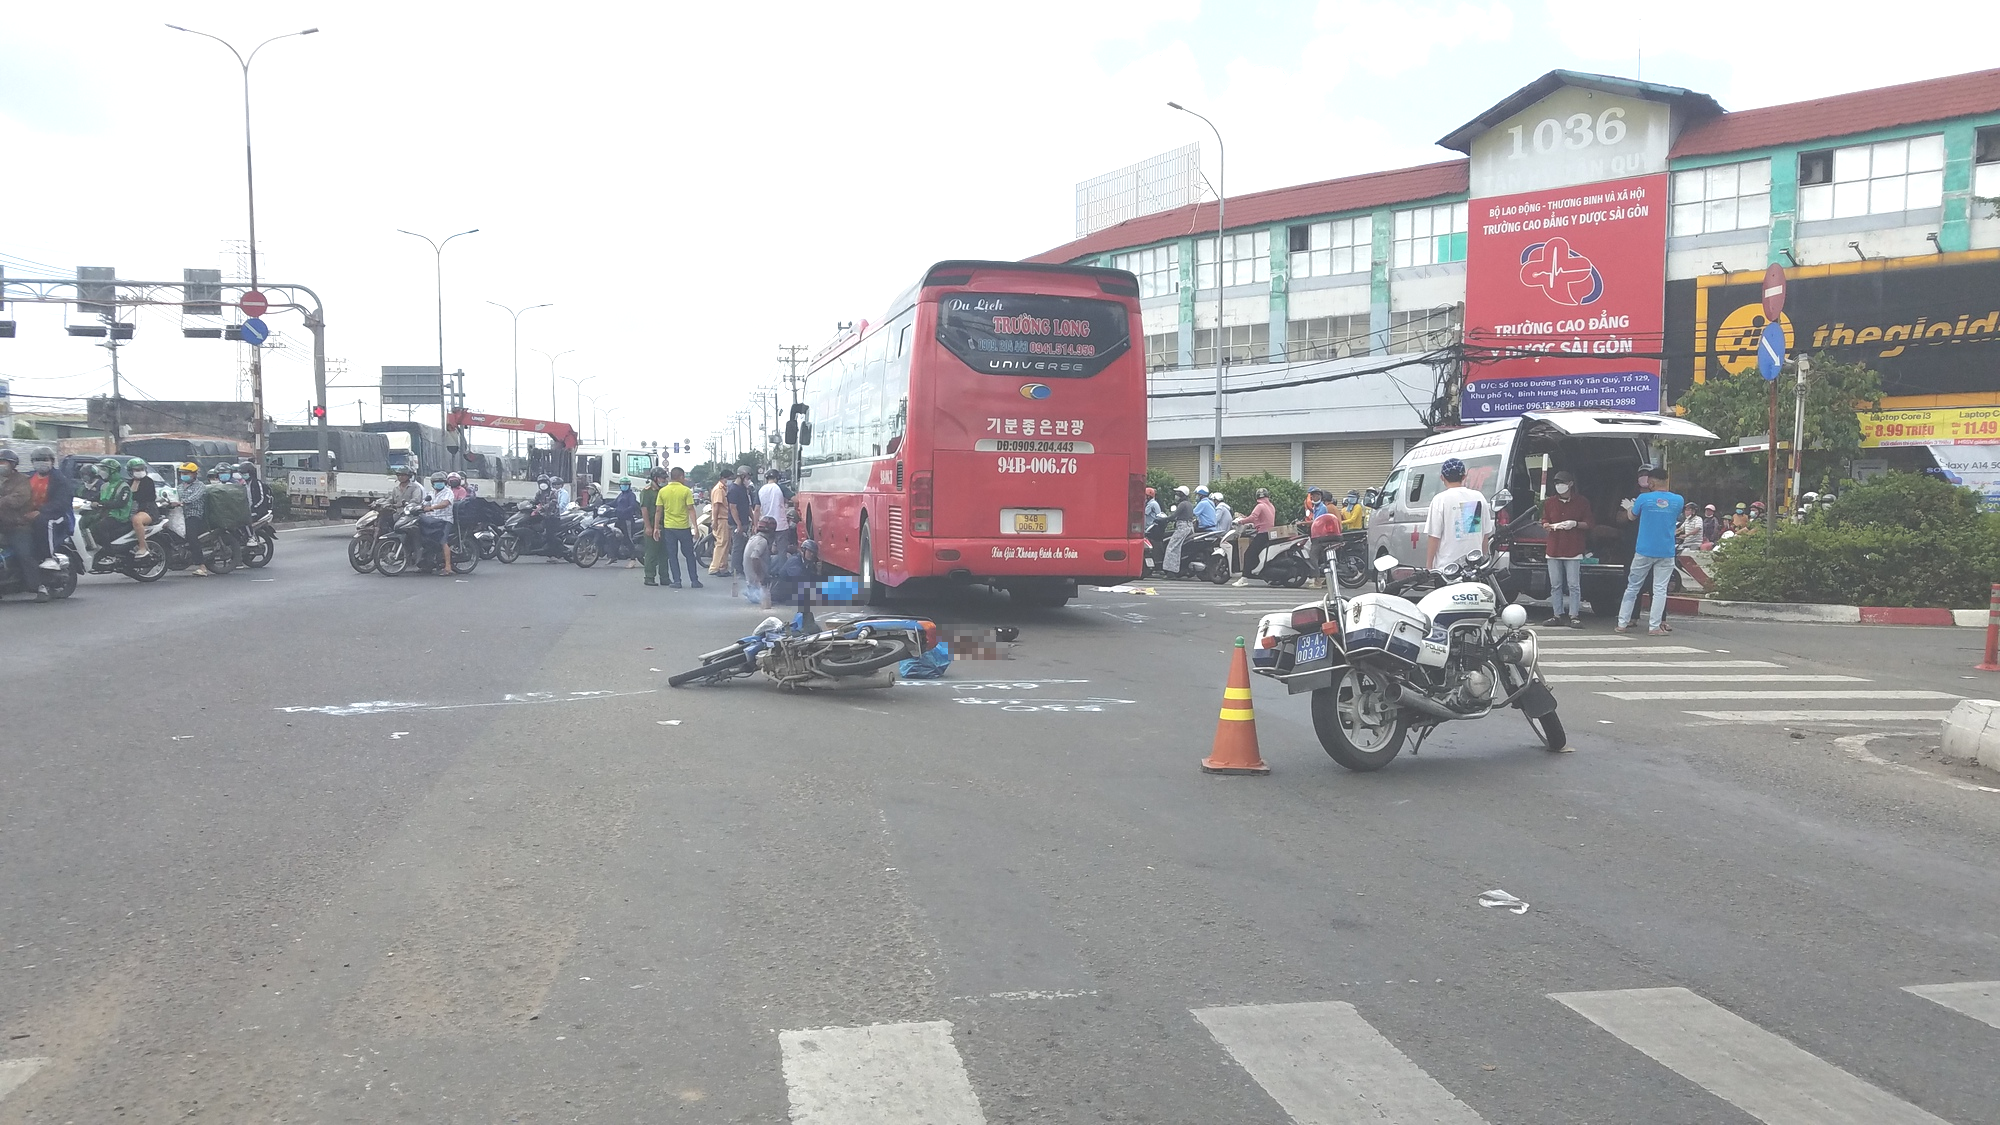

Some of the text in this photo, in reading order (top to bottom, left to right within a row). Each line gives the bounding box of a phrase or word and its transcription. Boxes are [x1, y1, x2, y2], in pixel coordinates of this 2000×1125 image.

[1508, 107, 1627, 160] 1036
[1489, 205, 1500, 219] BỘ
[1502, 206, 1517, 216] LAO
[1518, 202, 1540, 216] ĐỘNG
[1548, 197, 1582, 210] THƯƠNG
[1583, 194, 1603, 206] BINH
[1605, 190, 1615, 203] VÀ
[1617, 188, 1628, 201] XÃ
[1630, 186, 1645, 201] HỘI
[1483, 203, 1649, 235] TRƯỜNG CAO ĐẲNG Y DƯỢC SÀI GÒN
[949, 298, 1004, 313] Du Lịch
[993, 313, 1091, 338] TRƯỜNG LONG
[1494, 309, 1630, 337] TRƯỜNG CAO ĐẲNG
[1812, 310, 2000, 358] thegioid
[1029, 341, 1096, 356] 0941.514.959
[1560, 336, 1588, 354] SÀI
[1593, 334, 1633, 354] GÒN
[989, 360, 1083, 371] UNIVERSE
[1635, 374, 1650, 382] 129,
[1487, 391, 1502, 400] phố
[1537, 389, 1558, 397] Hưng
[1601, 386, 1617, 394] Tân,
[1619, 385, 1652, 393] TP.HCM.
[1494, 402, 1524, 411] Hotline:
[1922, 411, 1931, 419] i3
[1959, 410, 1991, 419] Laptop
[1875, 423, 1904, 437] 8.99
[1905, 423, 1935, 438] TRIỆU
[1964, 421, 1998, 435] 11.49
[996, 440, 1074, 452] DĐ:0909.204.443
[997, 456, 1078, 475] 94B-006.76
[1297, 644, 1326, 663] 003.23
[1424, 642, 1447, 654] POLICE
